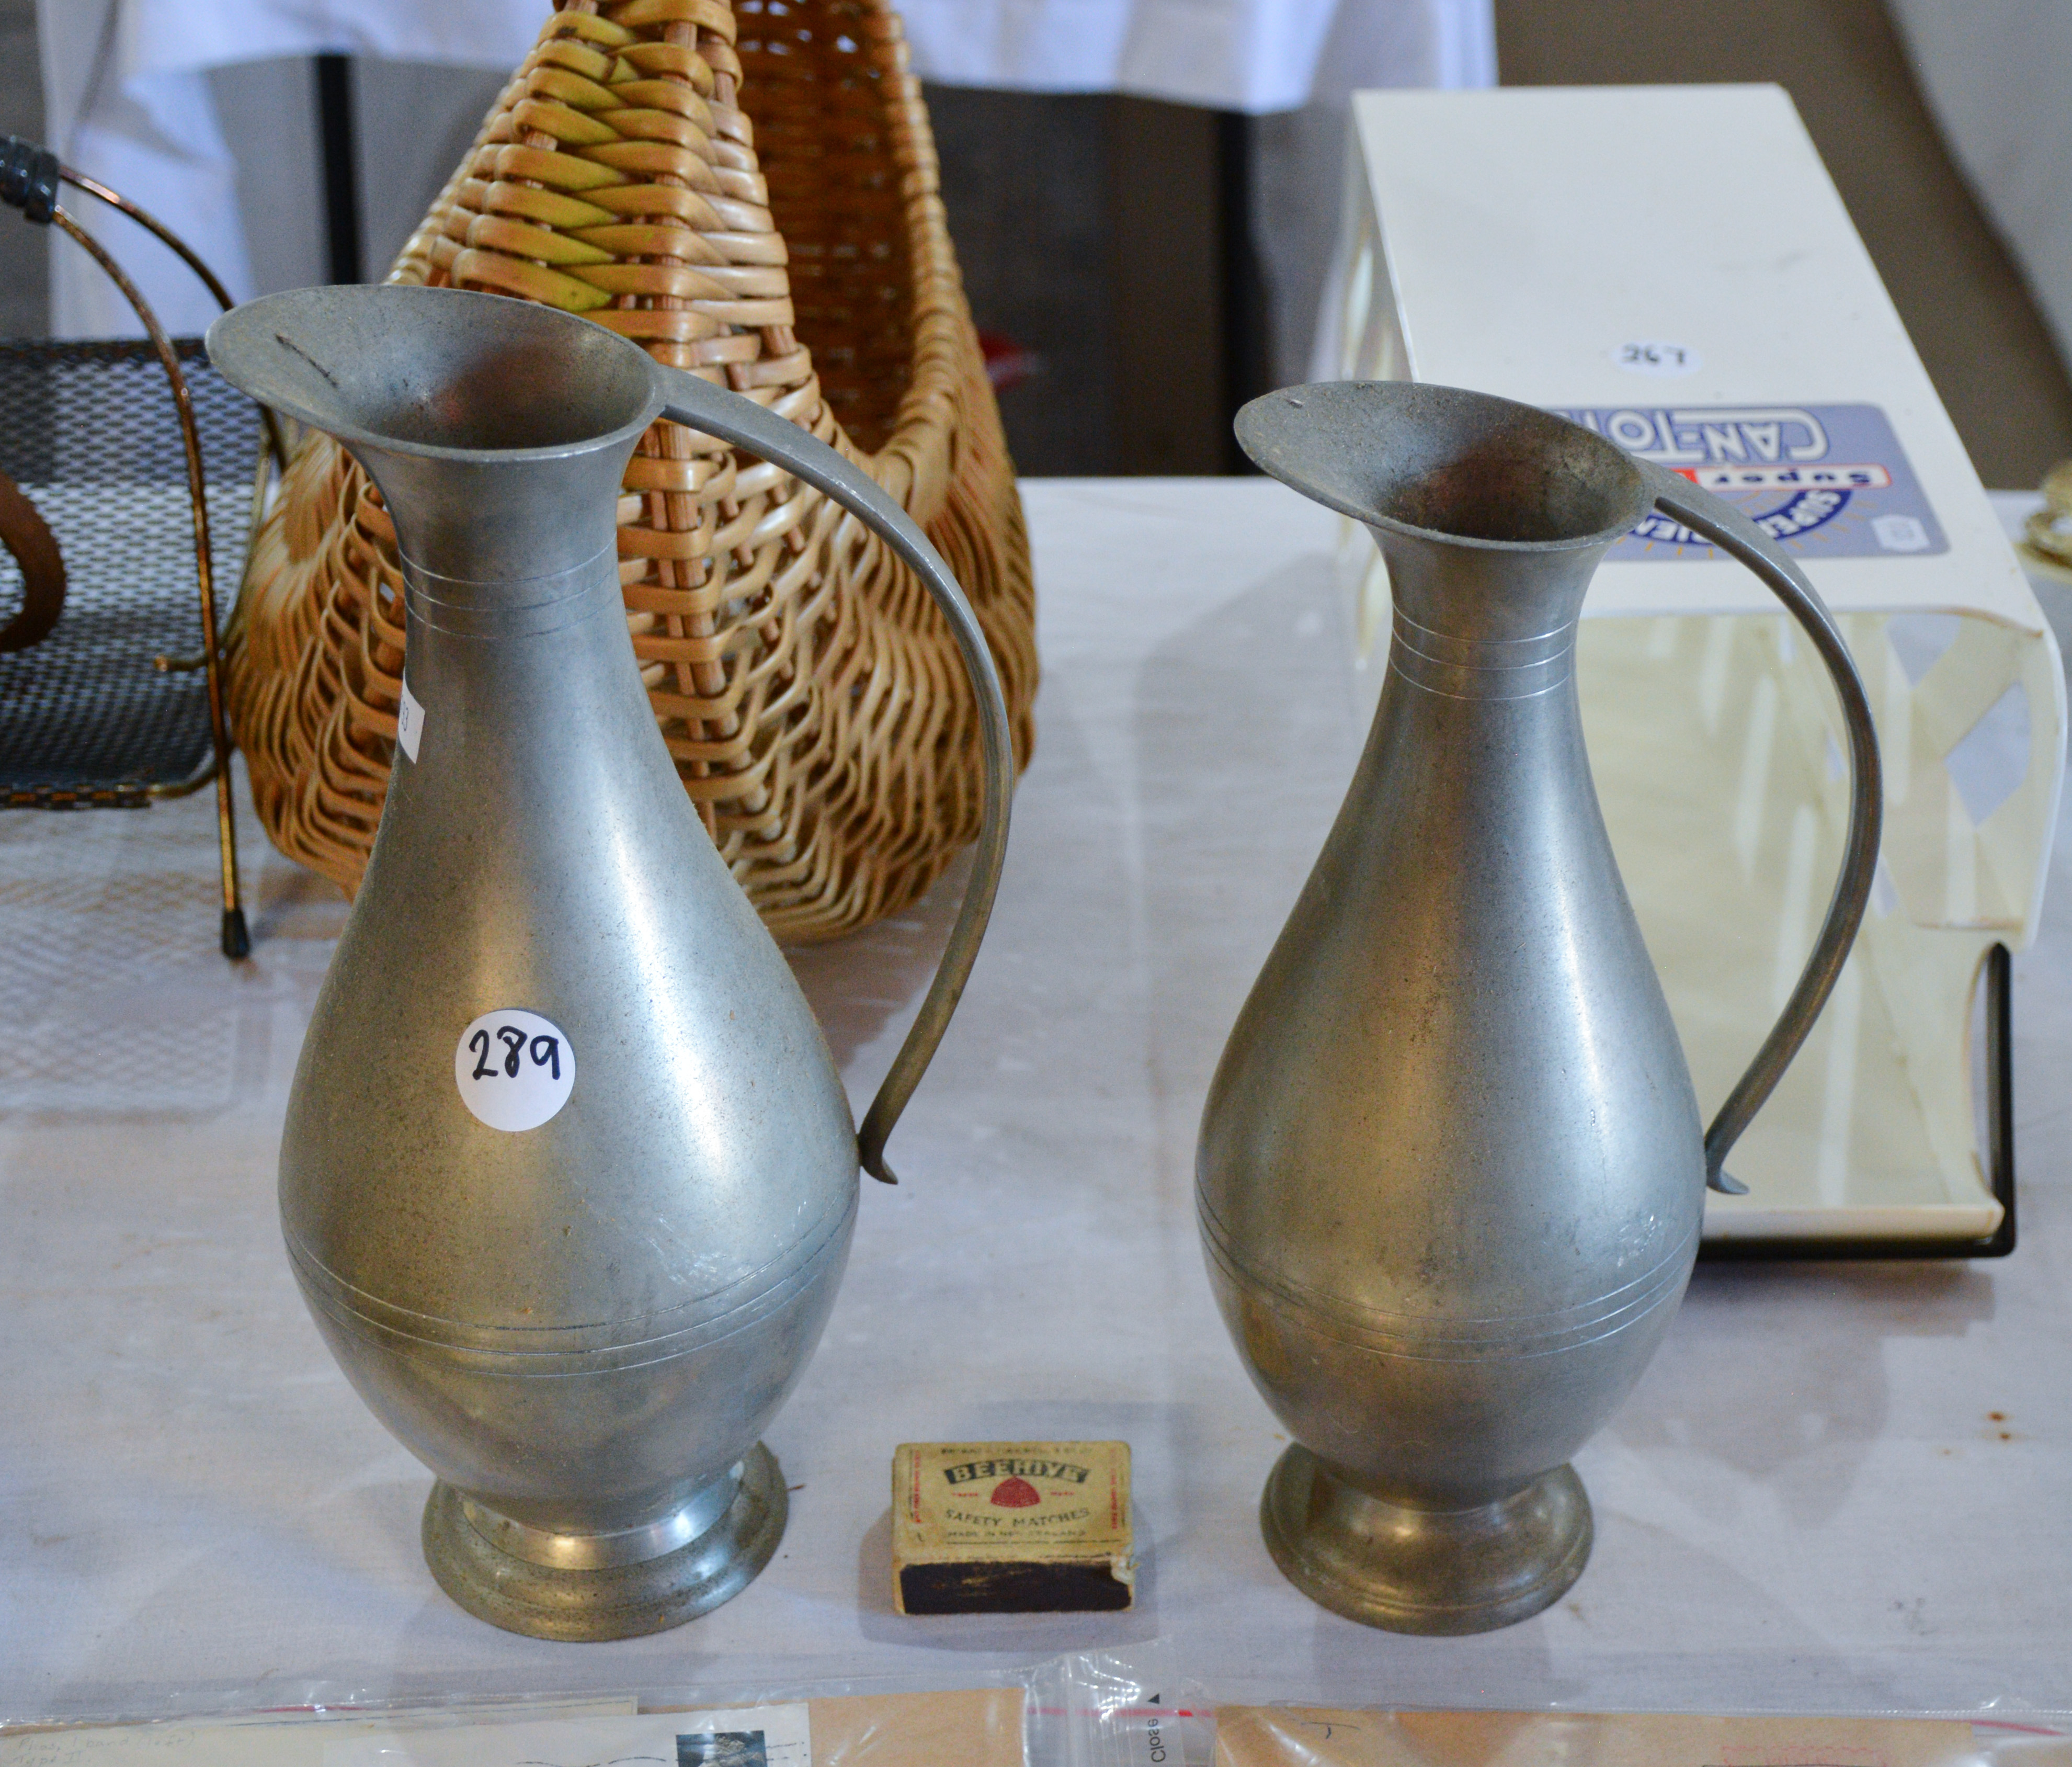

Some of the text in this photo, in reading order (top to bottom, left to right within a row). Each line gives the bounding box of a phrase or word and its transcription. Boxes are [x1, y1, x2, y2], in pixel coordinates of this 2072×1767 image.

[469, 1025, 561, 1080] 289
[949, 1459, 1085, 1483] BEEHIVE
[946, 1507, 1090, 1526] SAFETY MATCHES
